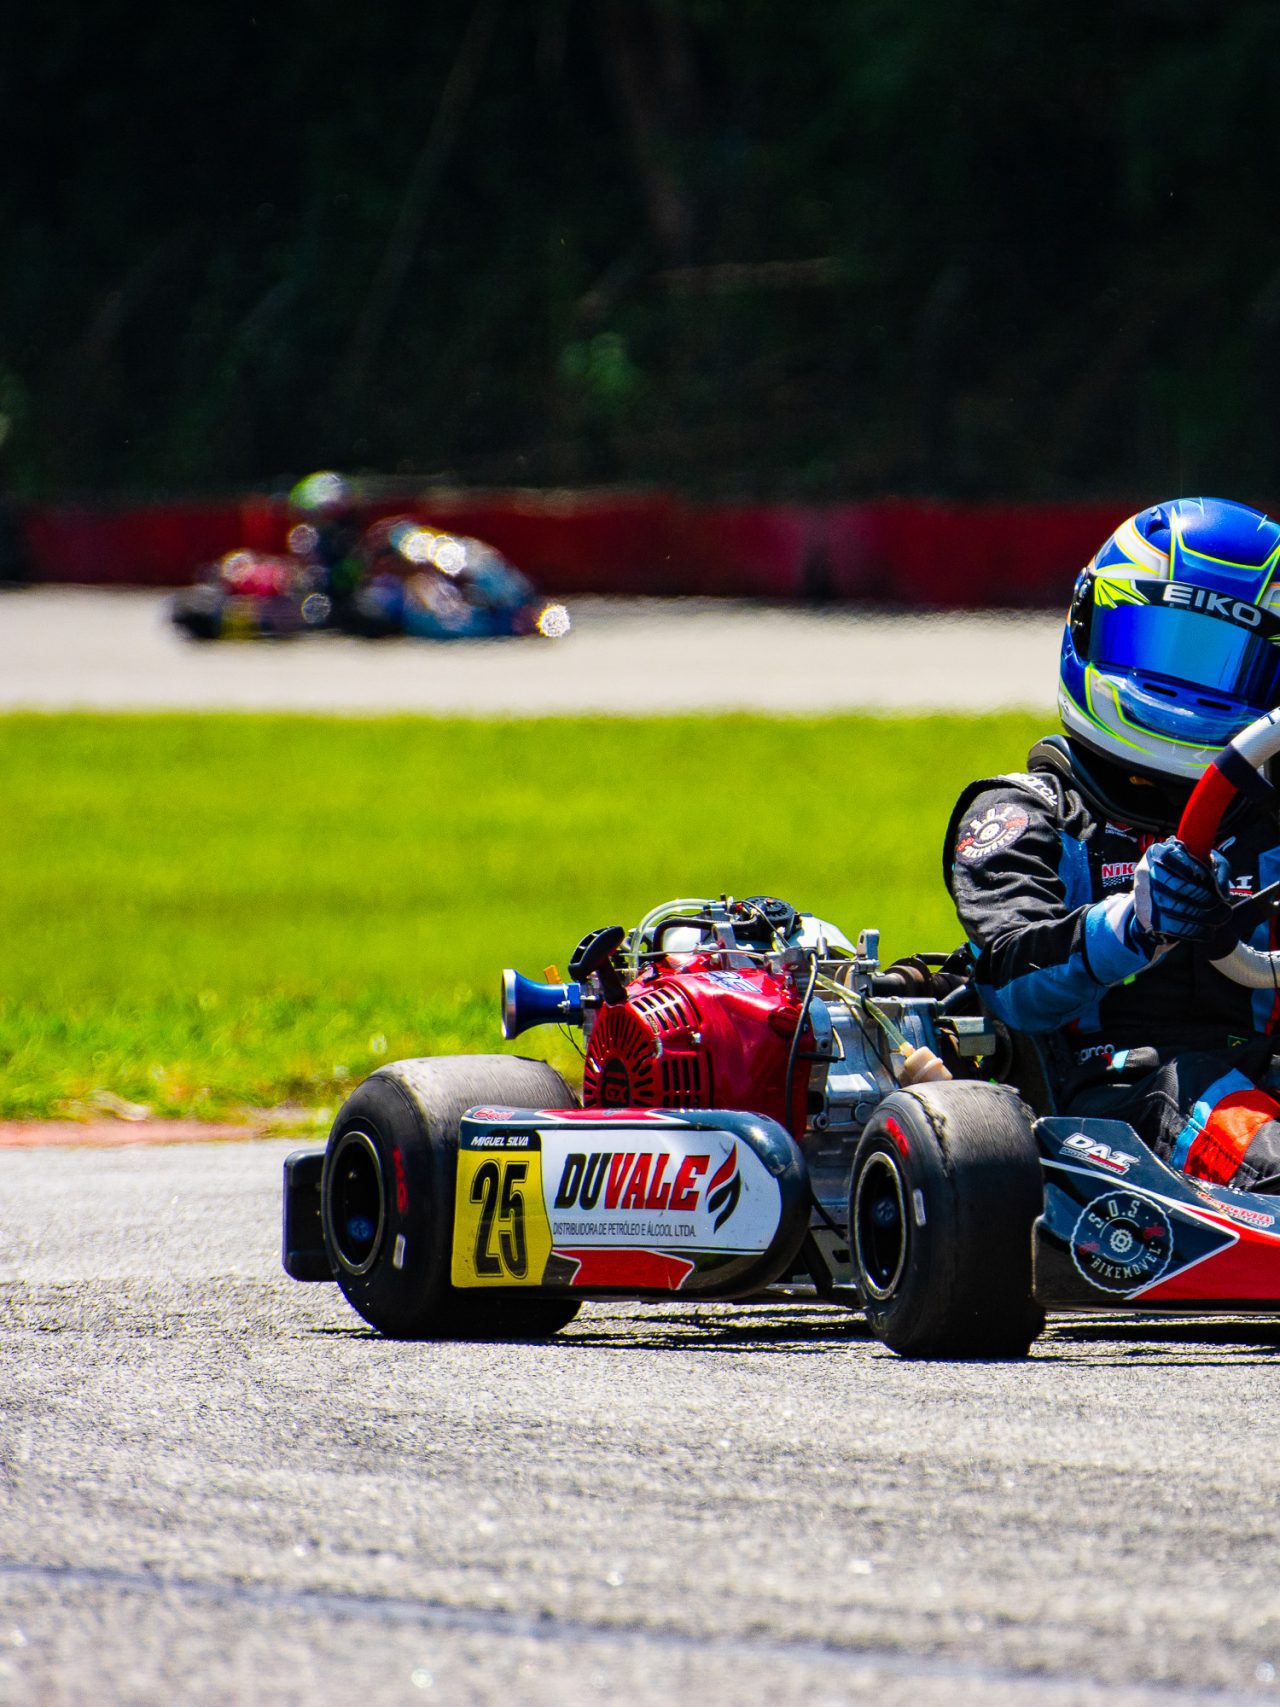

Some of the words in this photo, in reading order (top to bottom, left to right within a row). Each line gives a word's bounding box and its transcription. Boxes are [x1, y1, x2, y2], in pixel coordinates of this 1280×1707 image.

[1163, 584, 1262, 627] EIKO
[471, 1136, 505, 1146] MIGUEL
[506, 1136, 530, 1146] SILVA
[1063, 1133, 1140, 1168] DAI
[554, 1153, 711, 1211] DUVALE
[470, 1159, 529, 1279] 25
[552, 1222, 598, 1236] DISTRIBUIDORA
[599, 1223, 607, 1236] DE
[608, 1220, 640, 1236] PETRÓLEO
[647, 1221, 673, 1237] ÁLCOOL
[1091, 1247, 1162, 1279] BIKEMOVEL
